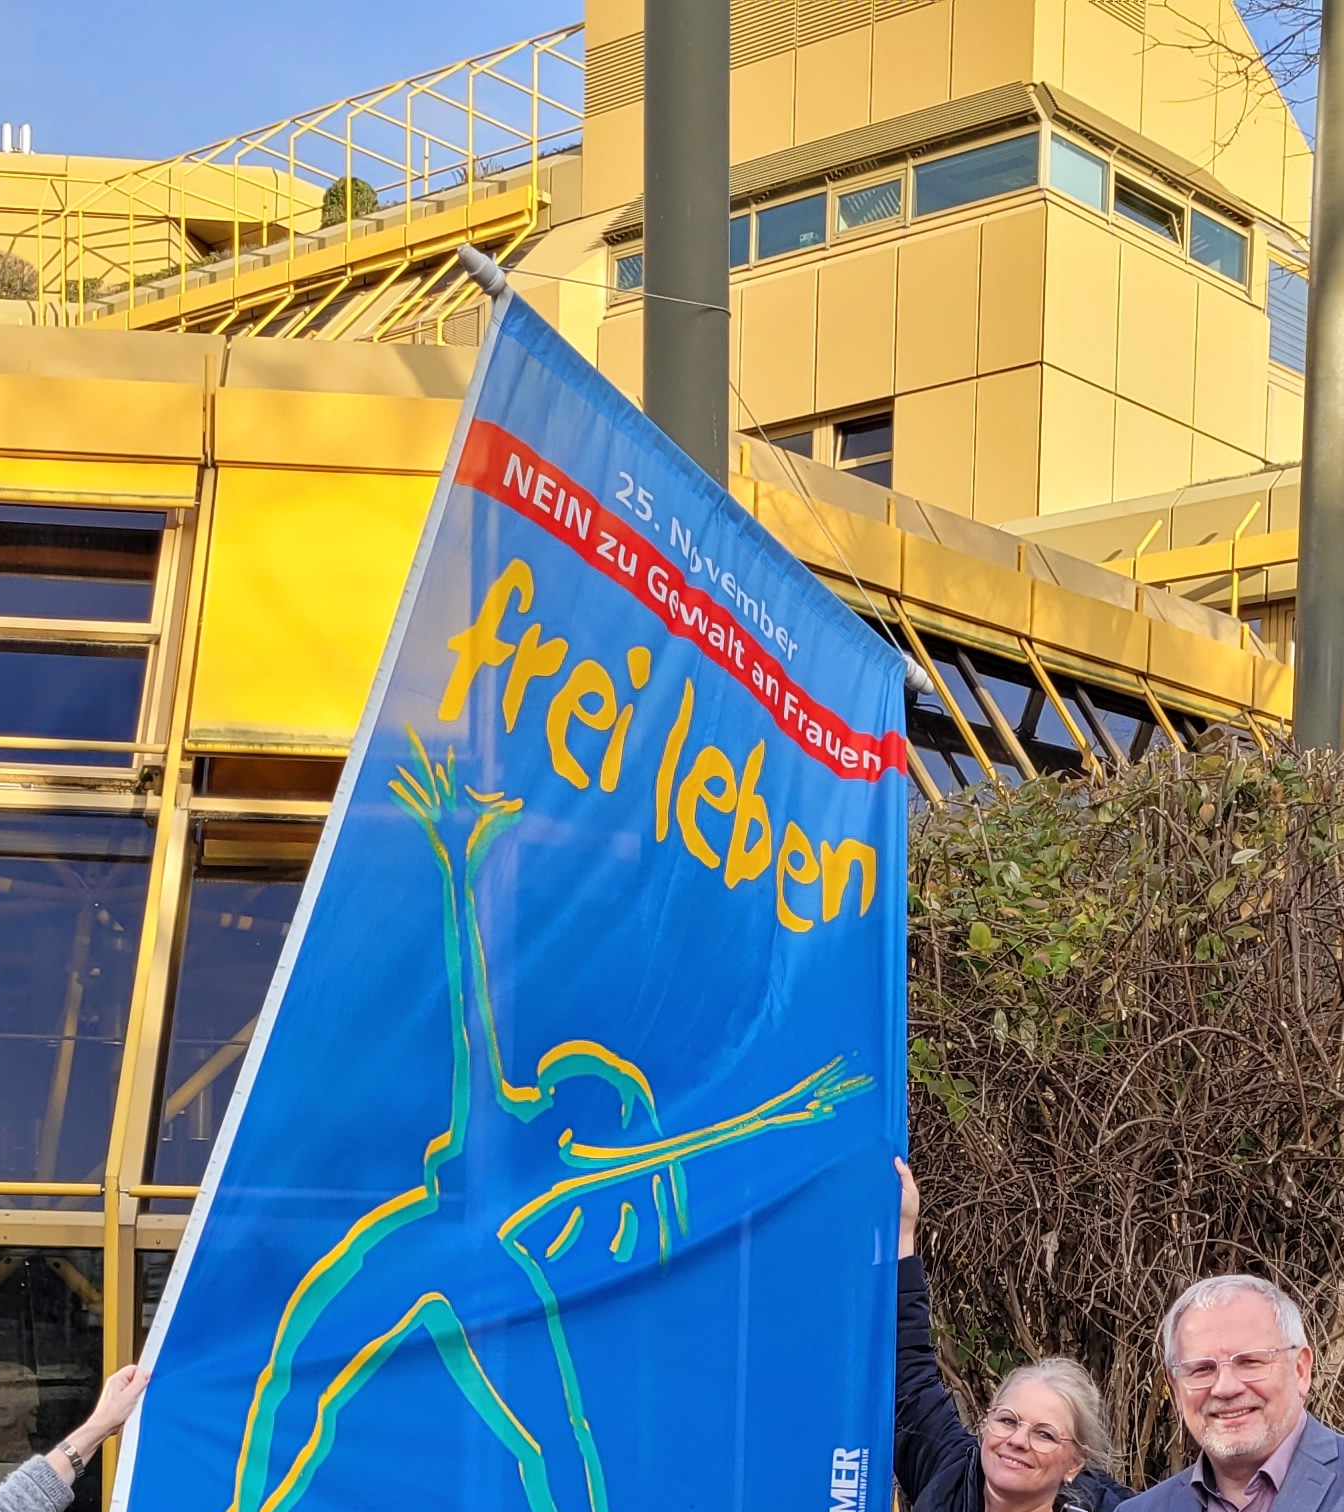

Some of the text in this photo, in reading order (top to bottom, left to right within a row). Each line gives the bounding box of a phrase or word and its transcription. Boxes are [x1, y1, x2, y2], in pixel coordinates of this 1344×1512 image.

[502, 452, 882, 773] NEIN zu Gewalt an Frauen
[614, 471, 799, 663] 25. November
[437, 558, 878, 933] frei leben
